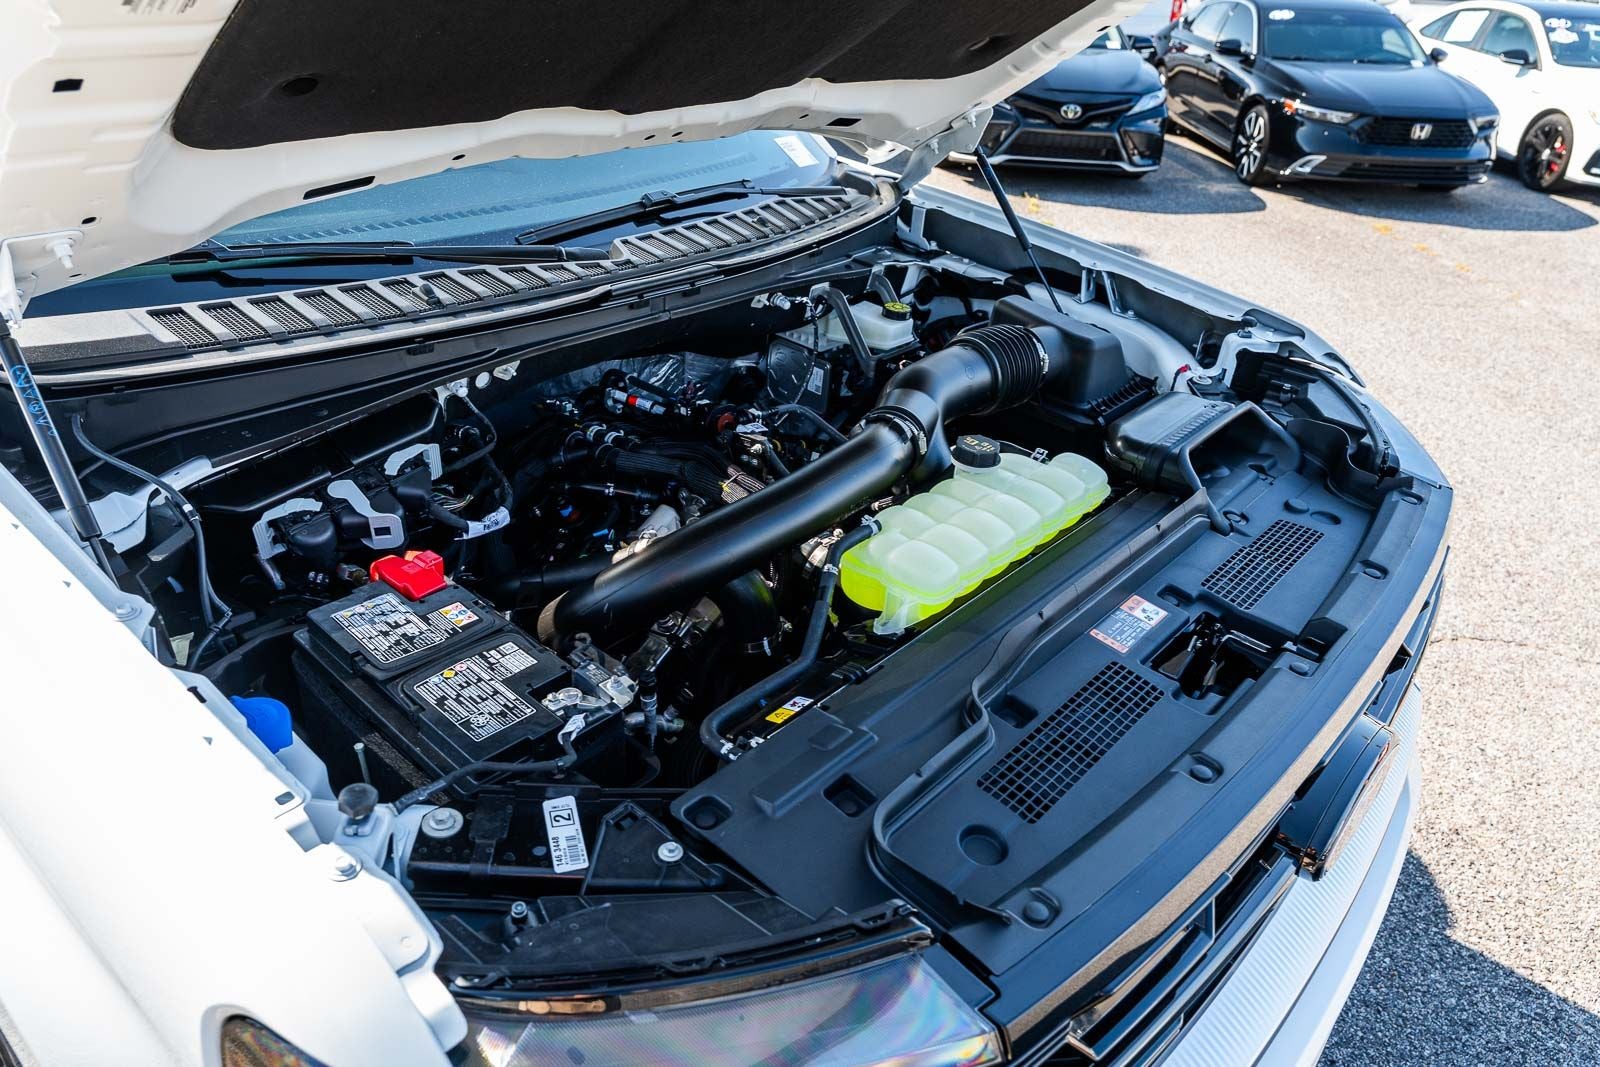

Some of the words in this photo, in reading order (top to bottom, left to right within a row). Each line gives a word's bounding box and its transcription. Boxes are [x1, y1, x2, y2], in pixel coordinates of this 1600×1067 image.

[553, 813, 571, 822] 2
[552, 836, 561, 852] 3448
[555, 854, 564, 866] 146
